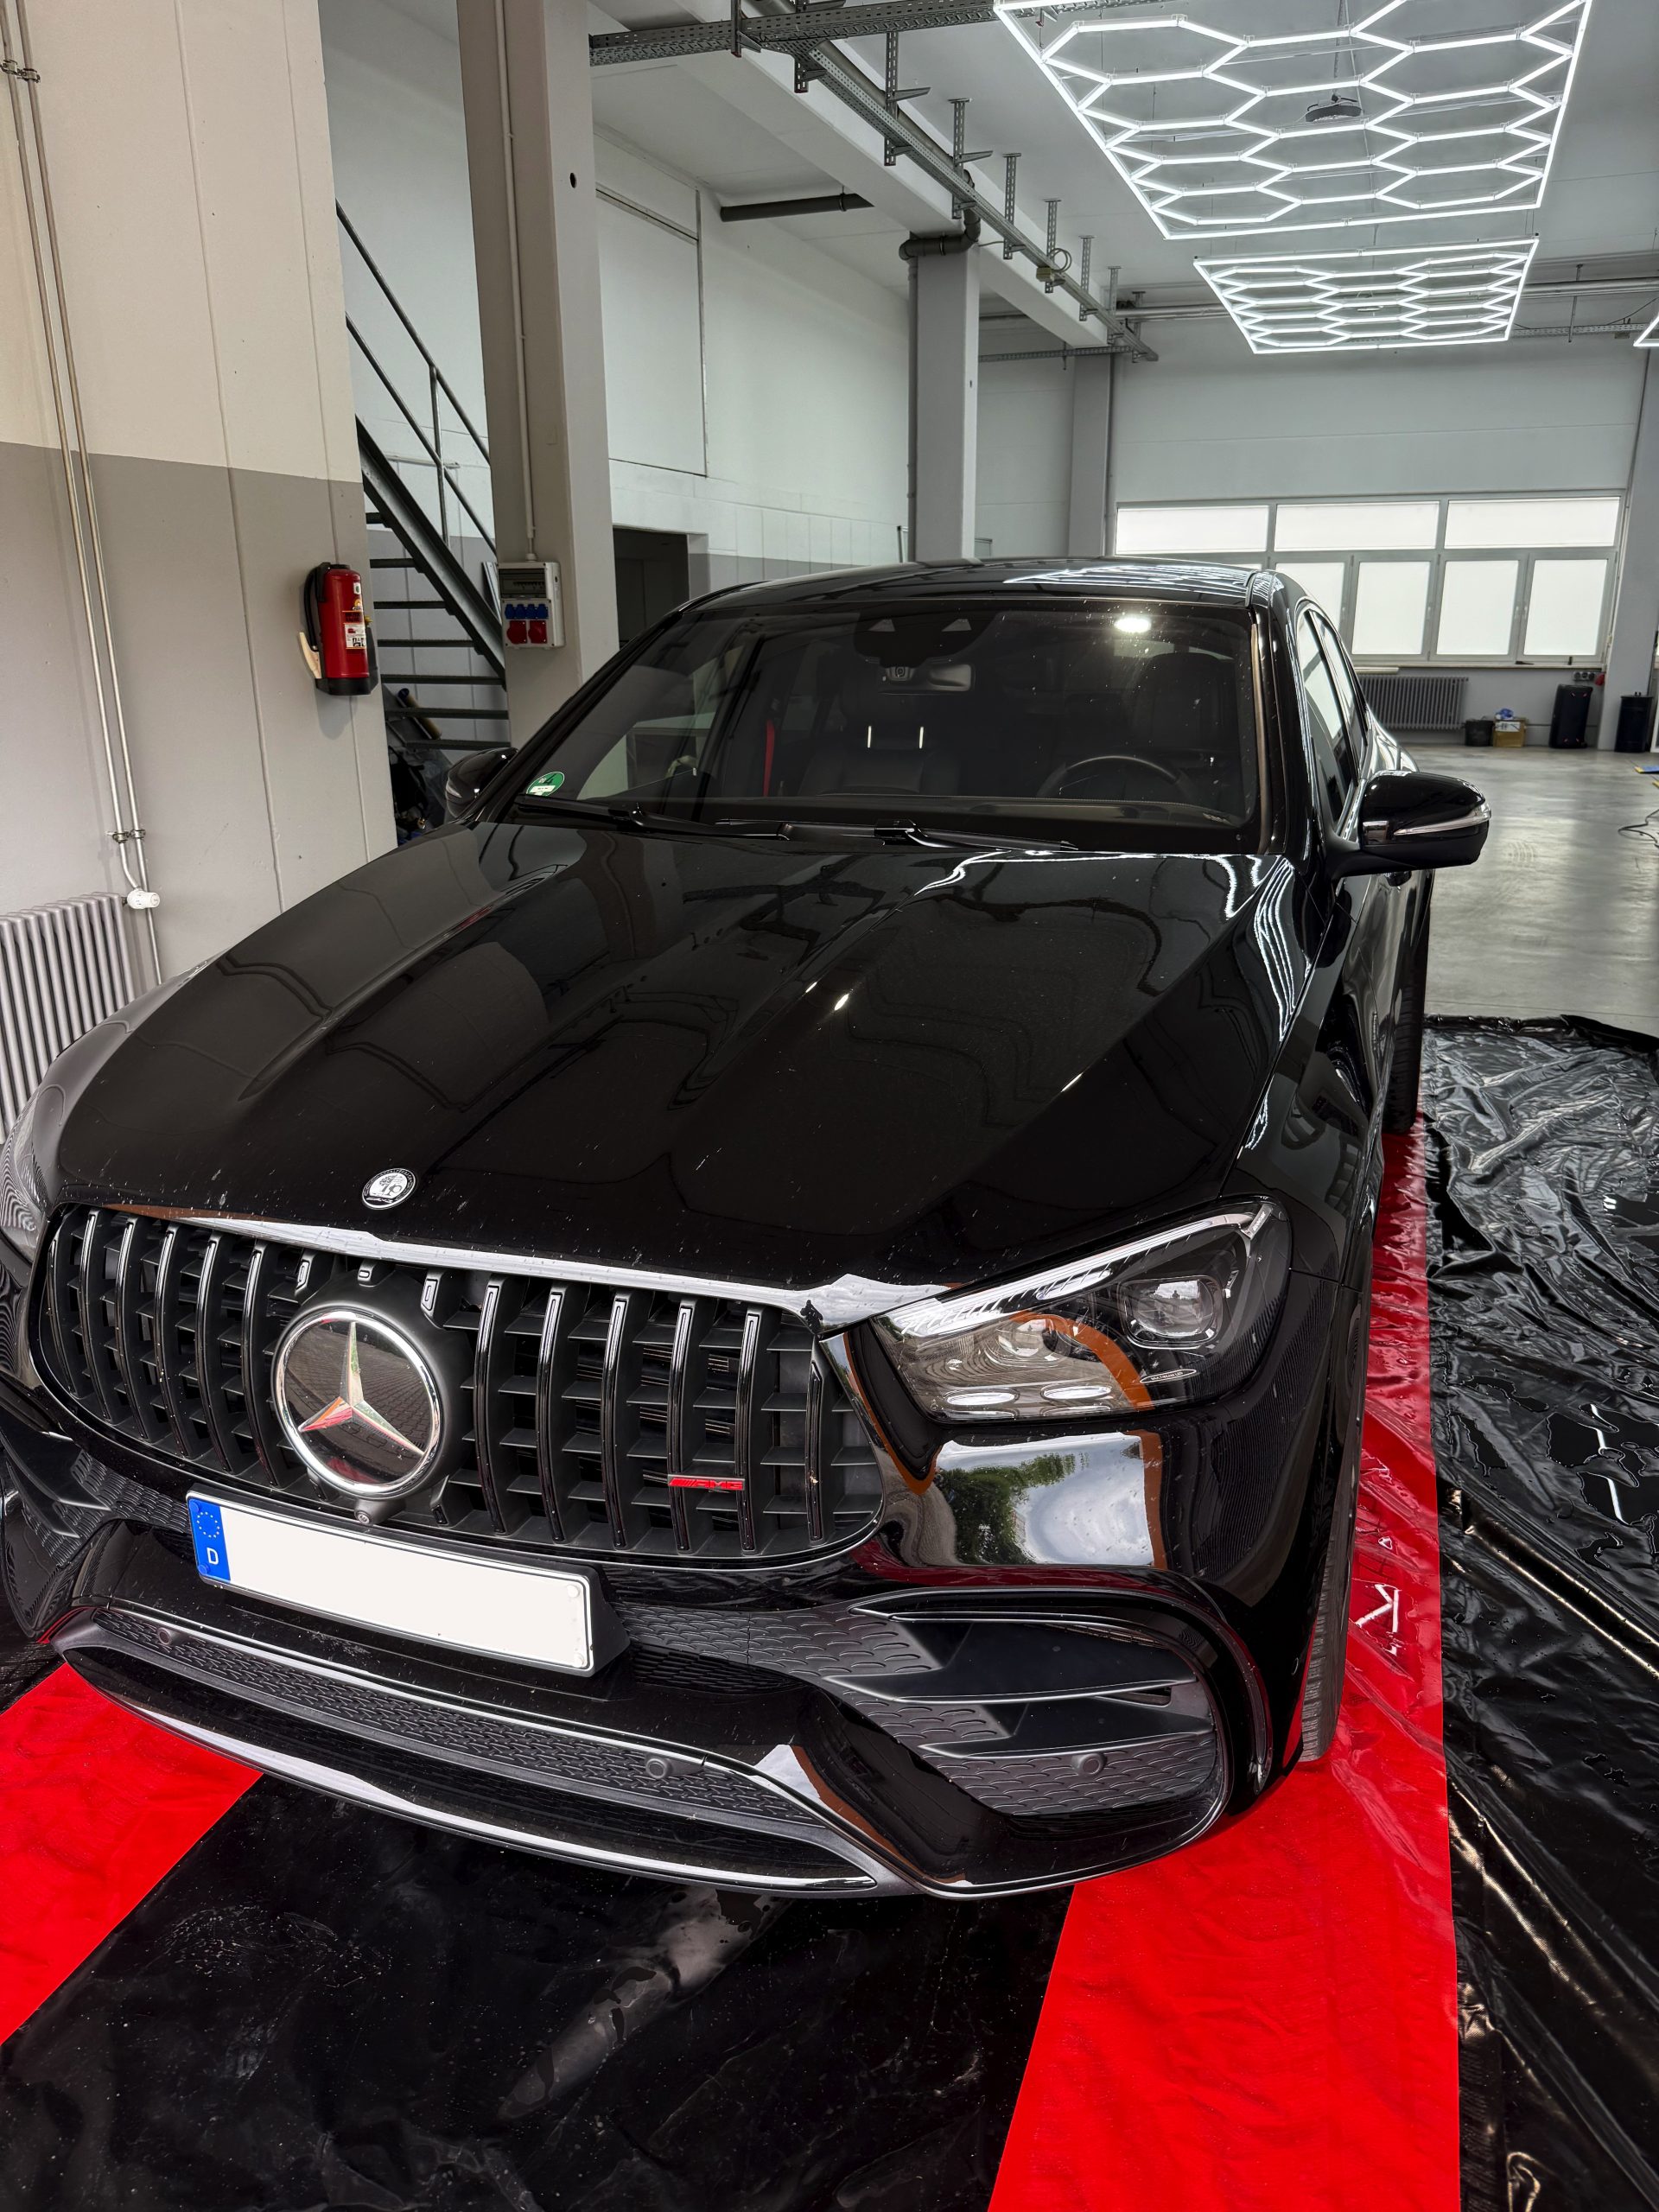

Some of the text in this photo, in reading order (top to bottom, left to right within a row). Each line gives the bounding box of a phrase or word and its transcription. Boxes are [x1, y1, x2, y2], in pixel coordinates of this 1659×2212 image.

[543, 773, 557, 785] 4
[690, 1478, 743, 1491] AMG
[207, 1547, 219, 1566] D
